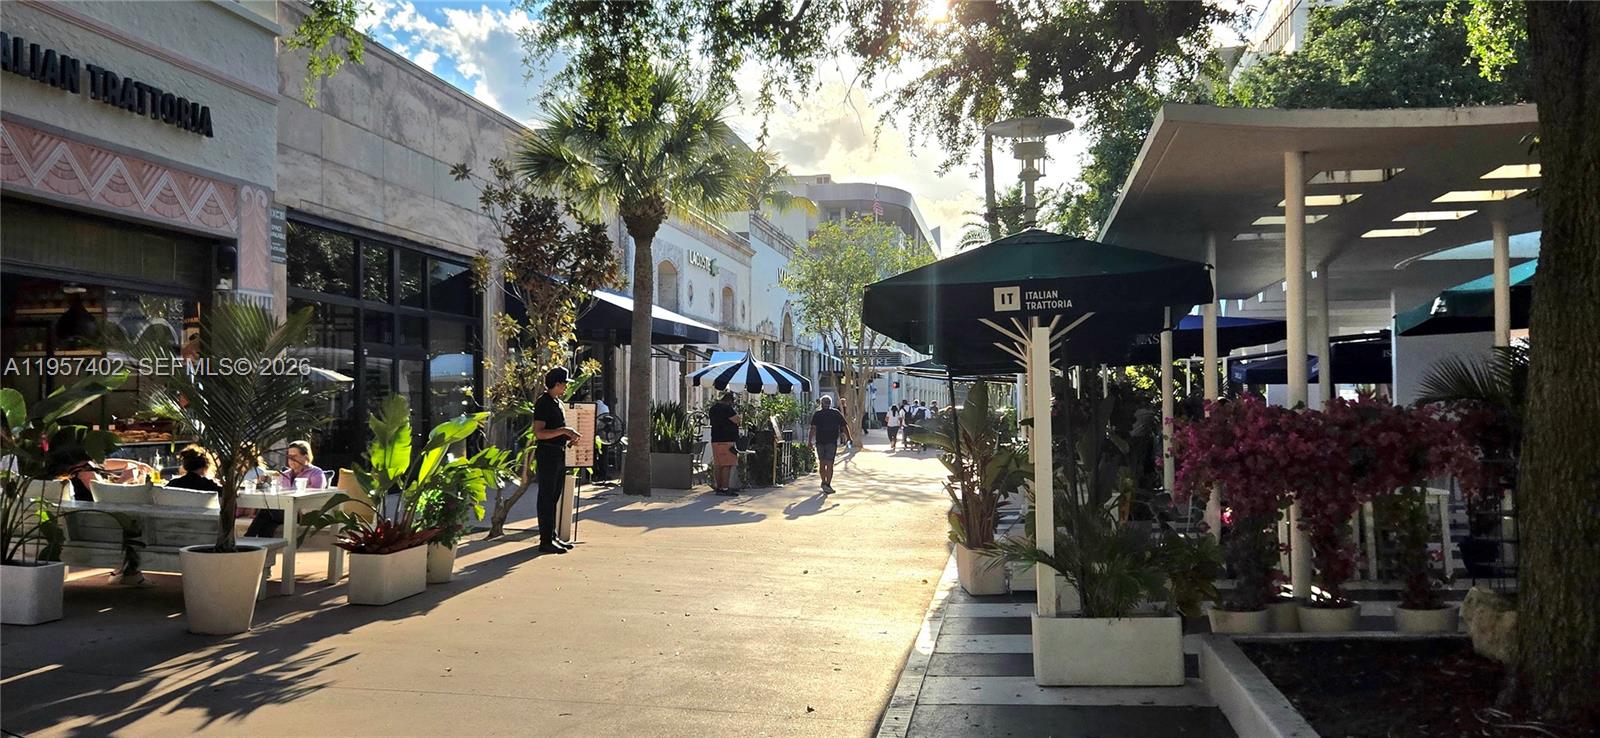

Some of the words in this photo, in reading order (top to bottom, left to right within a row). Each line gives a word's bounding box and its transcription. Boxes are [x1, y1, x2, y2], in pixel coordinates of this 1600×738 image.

[86, 63, 214, 138] TRATTORIA
[688, 248, 712, 269] LACOSTE
[1001, 293, 1014, 305] IT
[1025, 290, 1059, 300] ITALIAN
[1025, 300, 1073, 310] TRATTORIA
